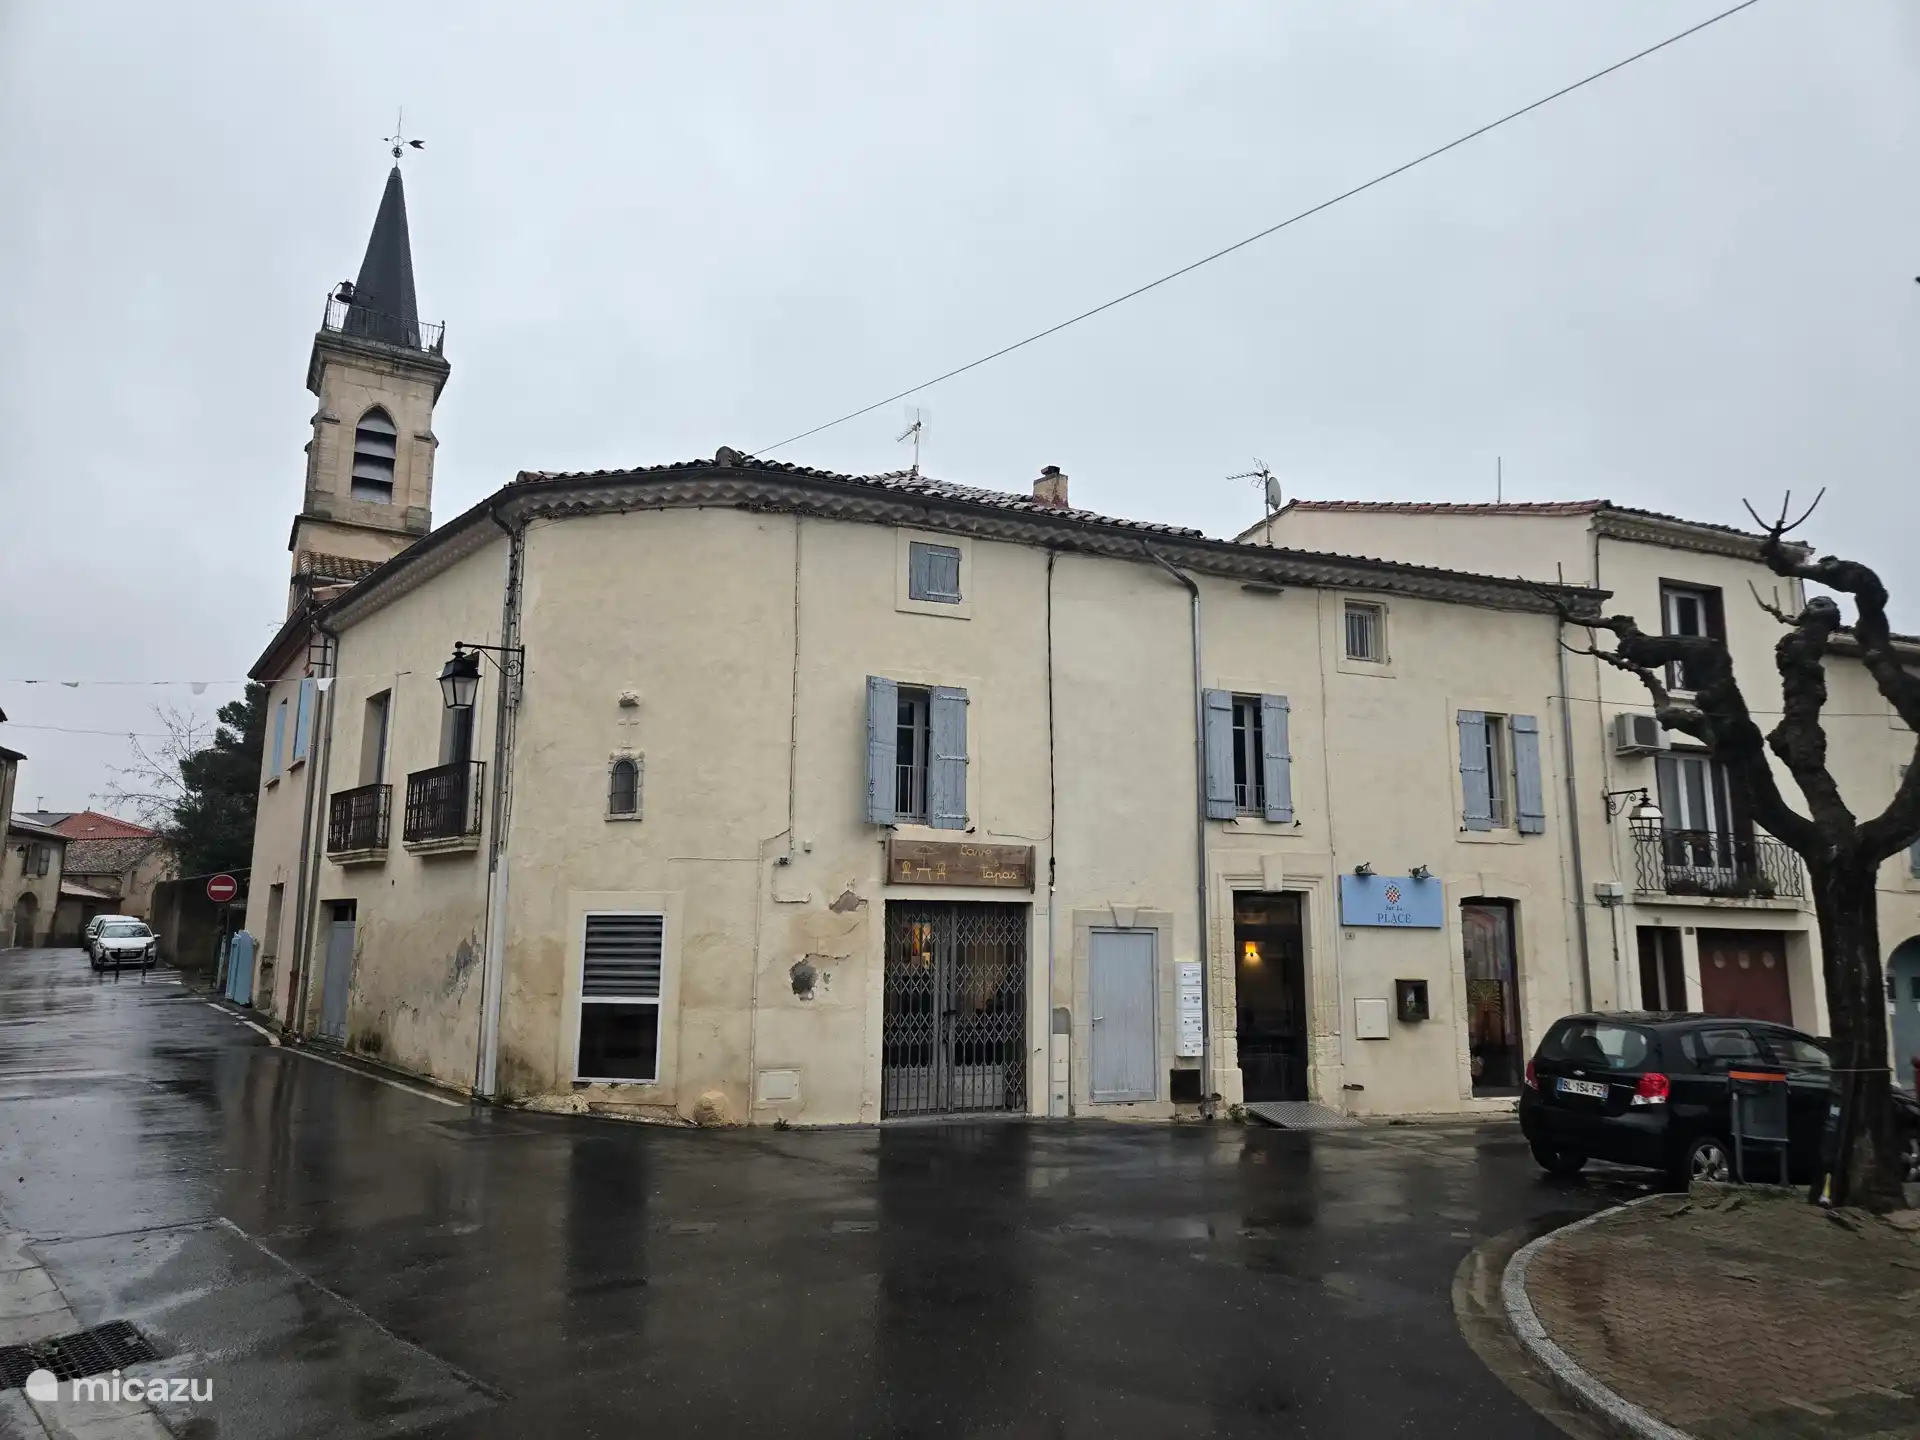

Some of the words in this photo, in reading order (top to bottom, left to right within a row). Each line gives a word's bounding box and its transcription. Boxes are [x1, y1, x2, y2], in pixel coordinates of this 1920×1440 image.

[960, 844, 992, 857] Cave
[980, 866, 1017, 885] Tapas
[1377, 912, 1412, 924] PLACE
